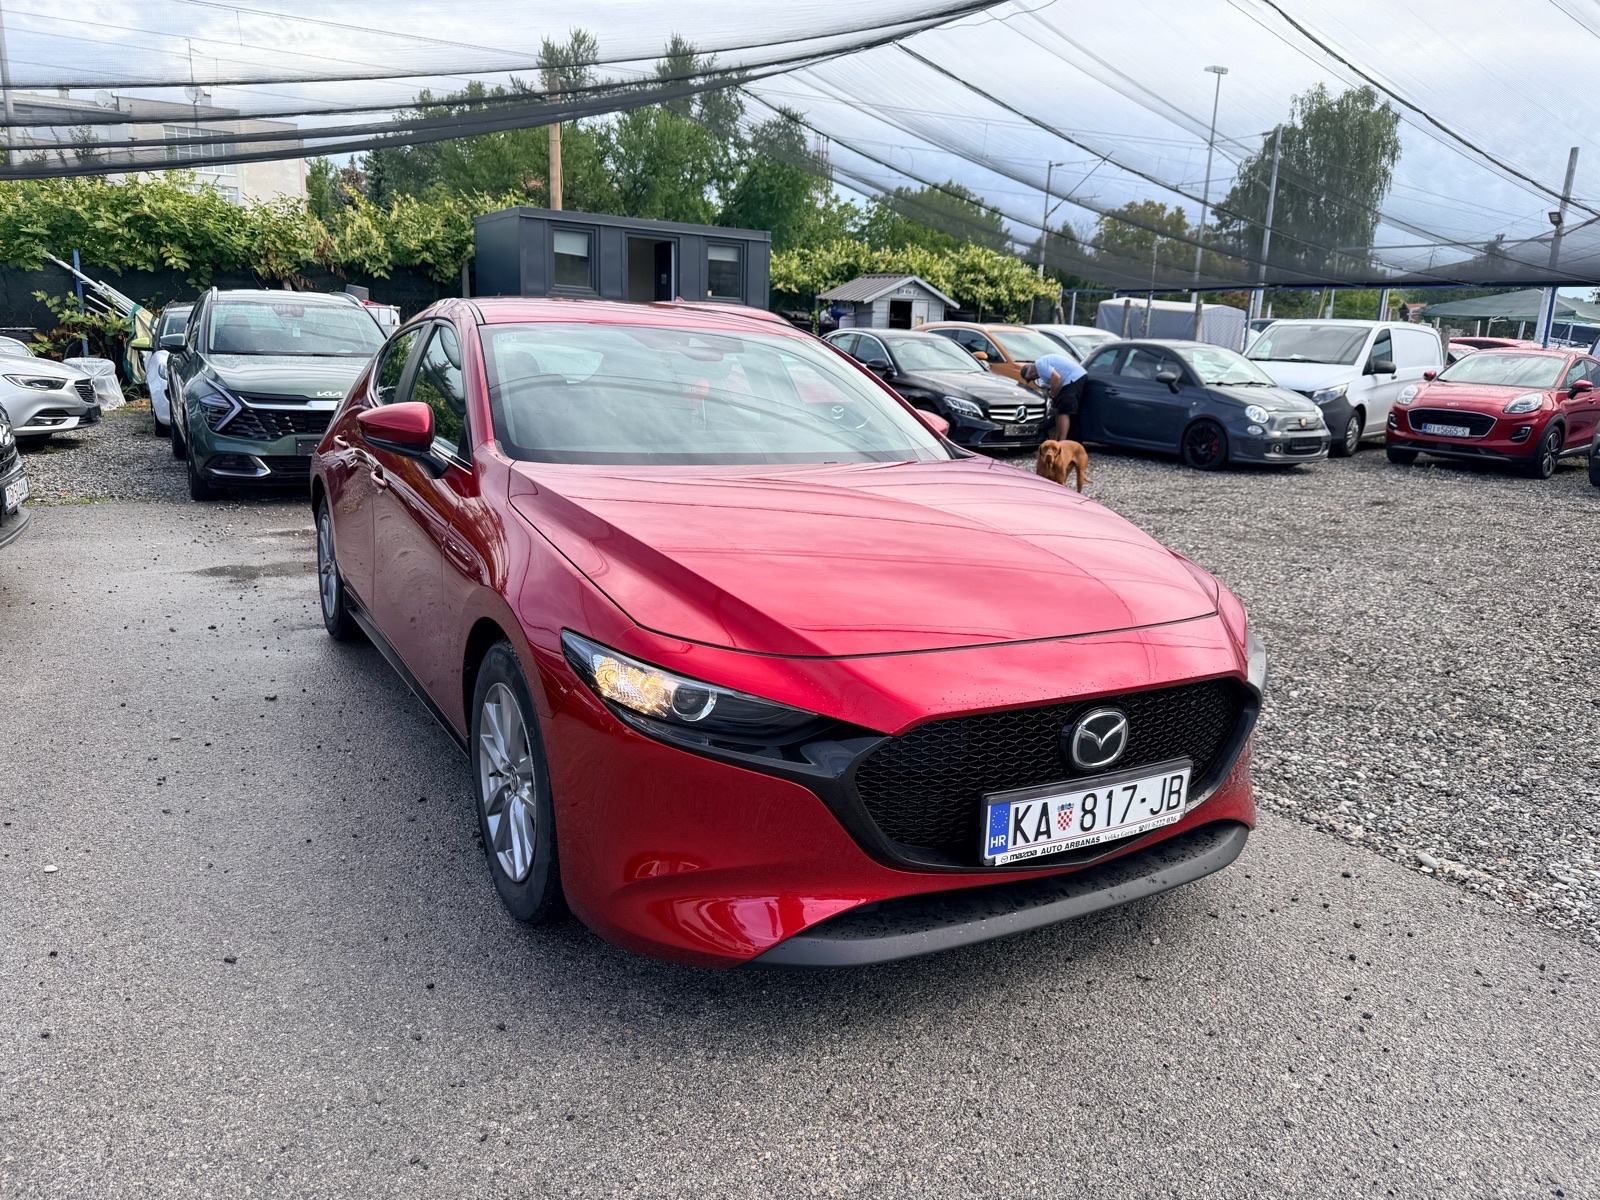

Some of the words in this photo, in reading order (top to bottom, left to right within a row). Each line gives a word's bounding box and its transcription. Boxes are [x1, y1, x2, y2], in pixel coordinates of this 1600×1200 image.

[1012, 801, 1052, 846] KA
[990, 835, 1006, 849] HR
[1040, 844, 1063, 856] AUTO
[1064, 835, 1101, 850] ARBANAS
